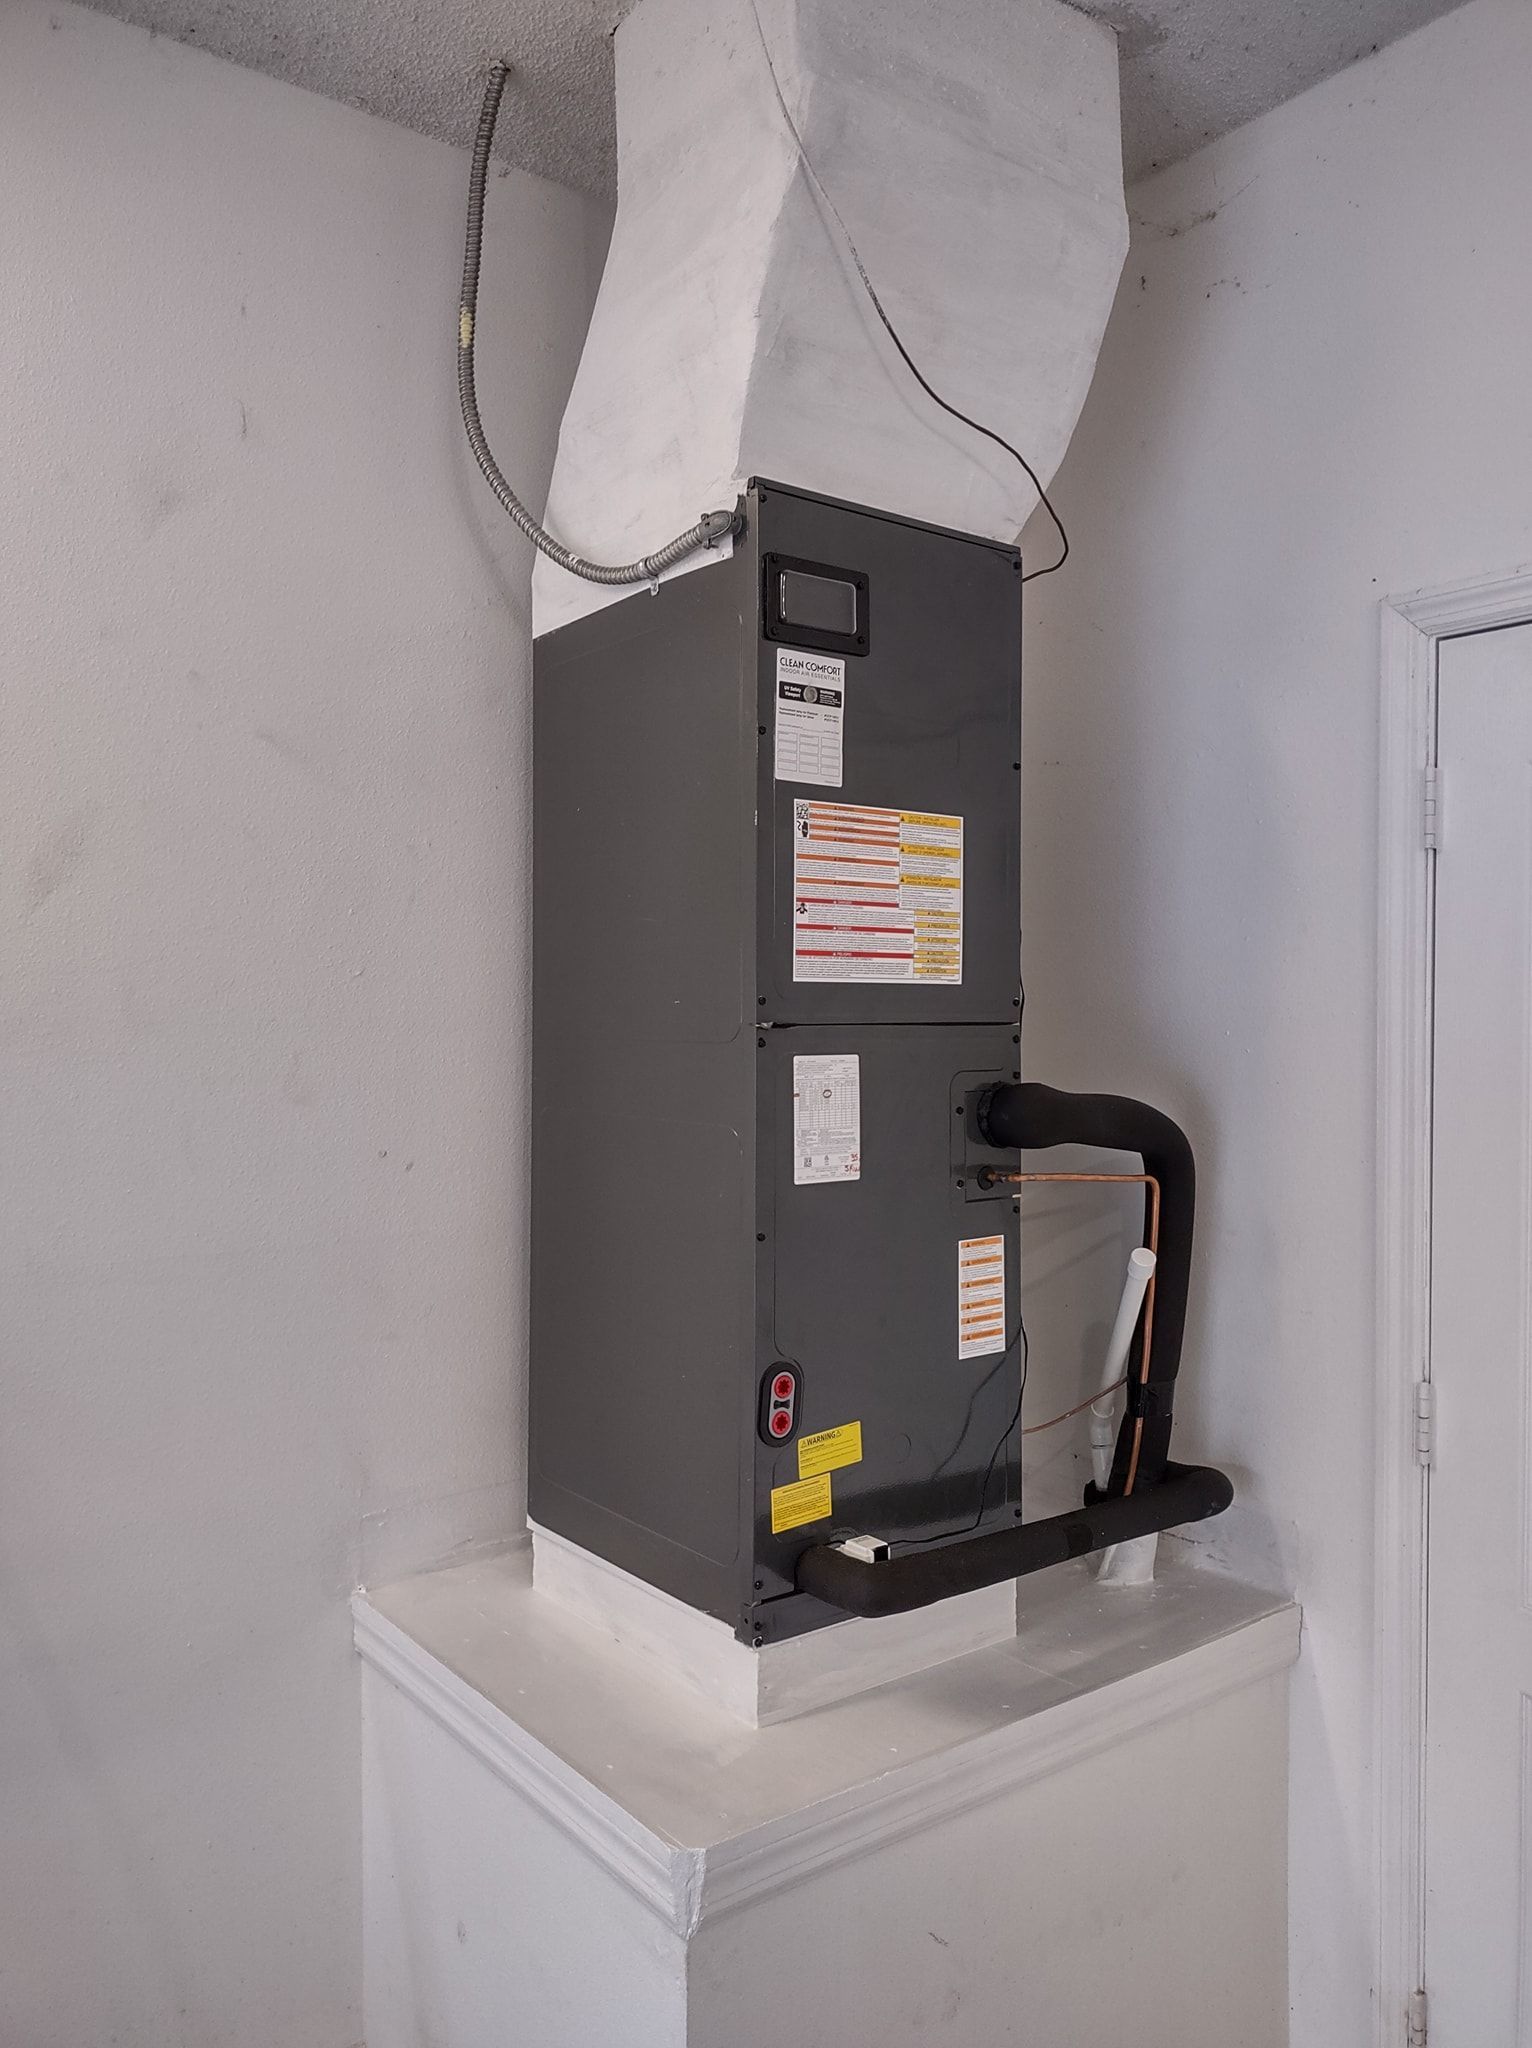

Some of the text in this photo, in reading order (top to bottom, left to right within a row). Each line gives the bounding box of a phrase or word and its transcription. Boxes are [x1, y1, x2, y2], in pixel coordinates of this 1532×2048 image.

[780, 657, 840, 675] CLEAN COMFORT
[806, 1432, 835, 1446] WARNING
